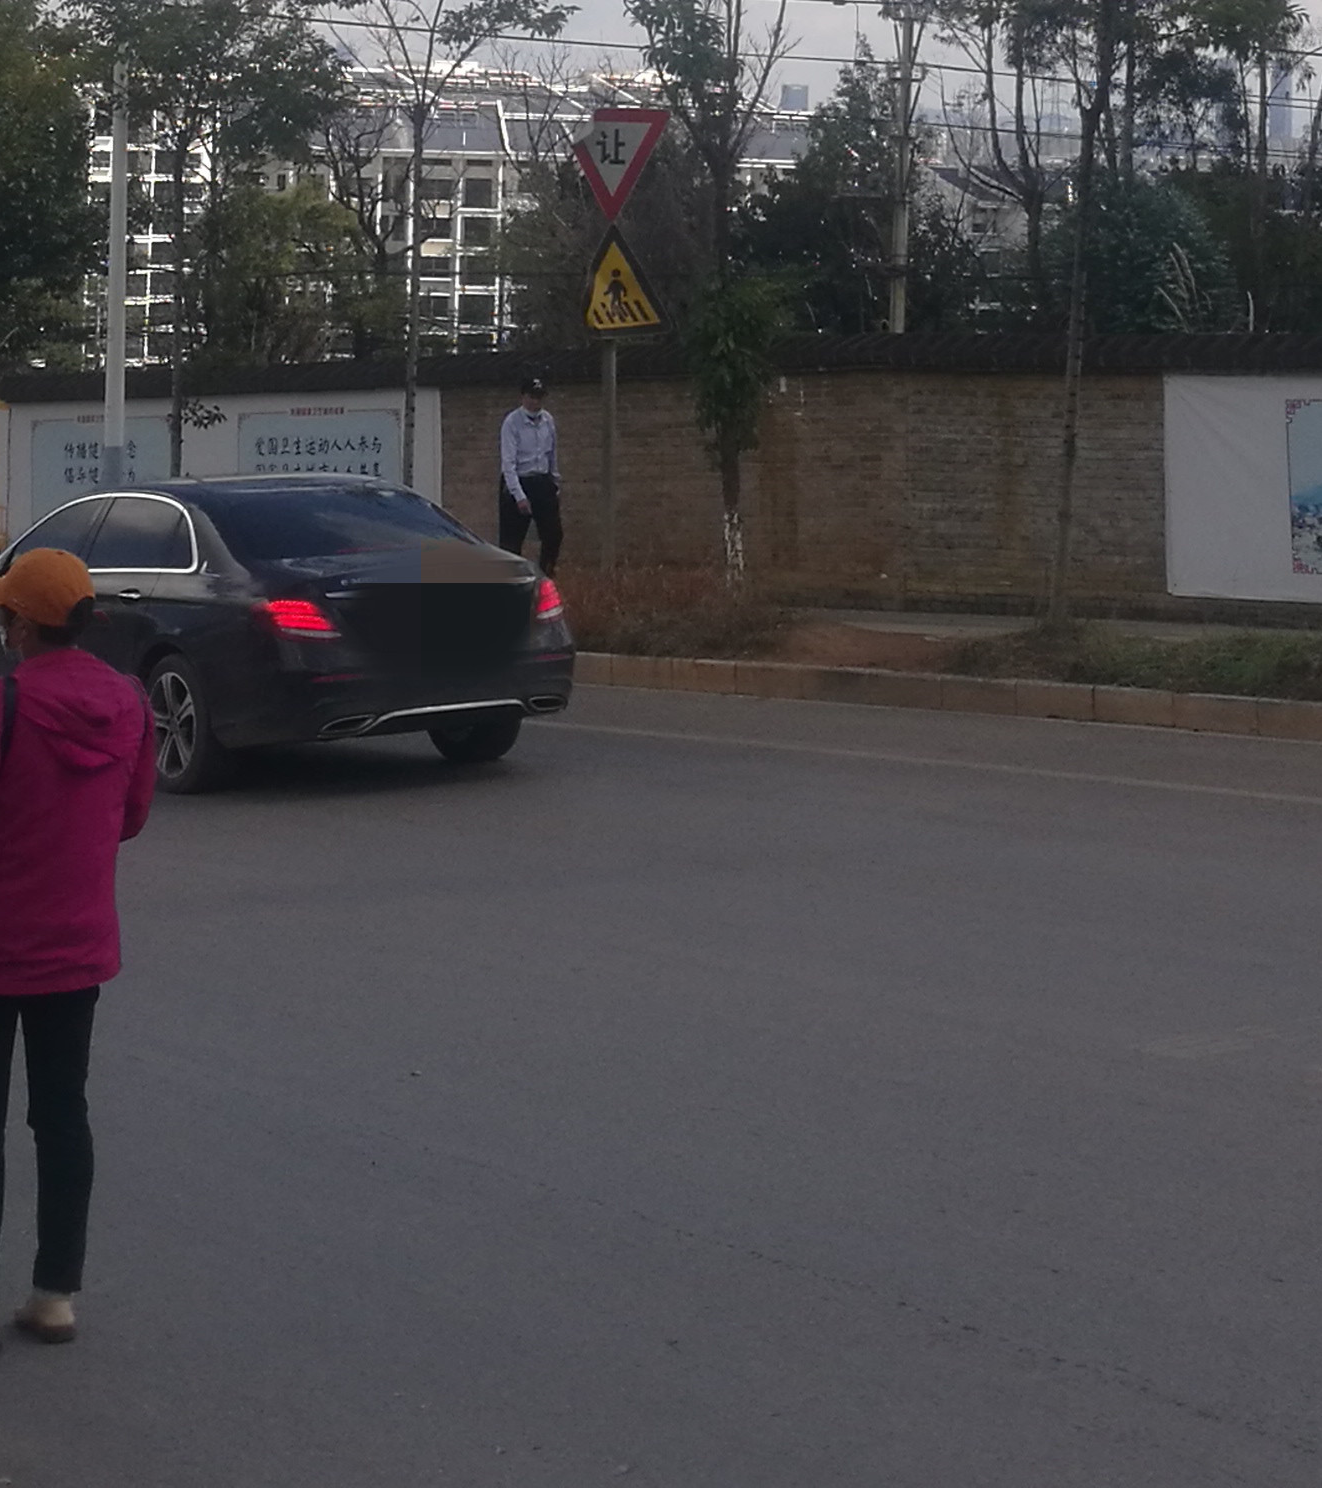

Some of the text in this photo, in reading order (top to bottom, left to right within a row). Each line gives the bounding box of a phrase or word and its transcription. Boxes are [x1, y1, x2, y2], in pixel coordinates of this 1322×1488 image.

[595, 128, 626, 165] 让
[255, 435, 382, 456] 爱国卫生运动人人参与
